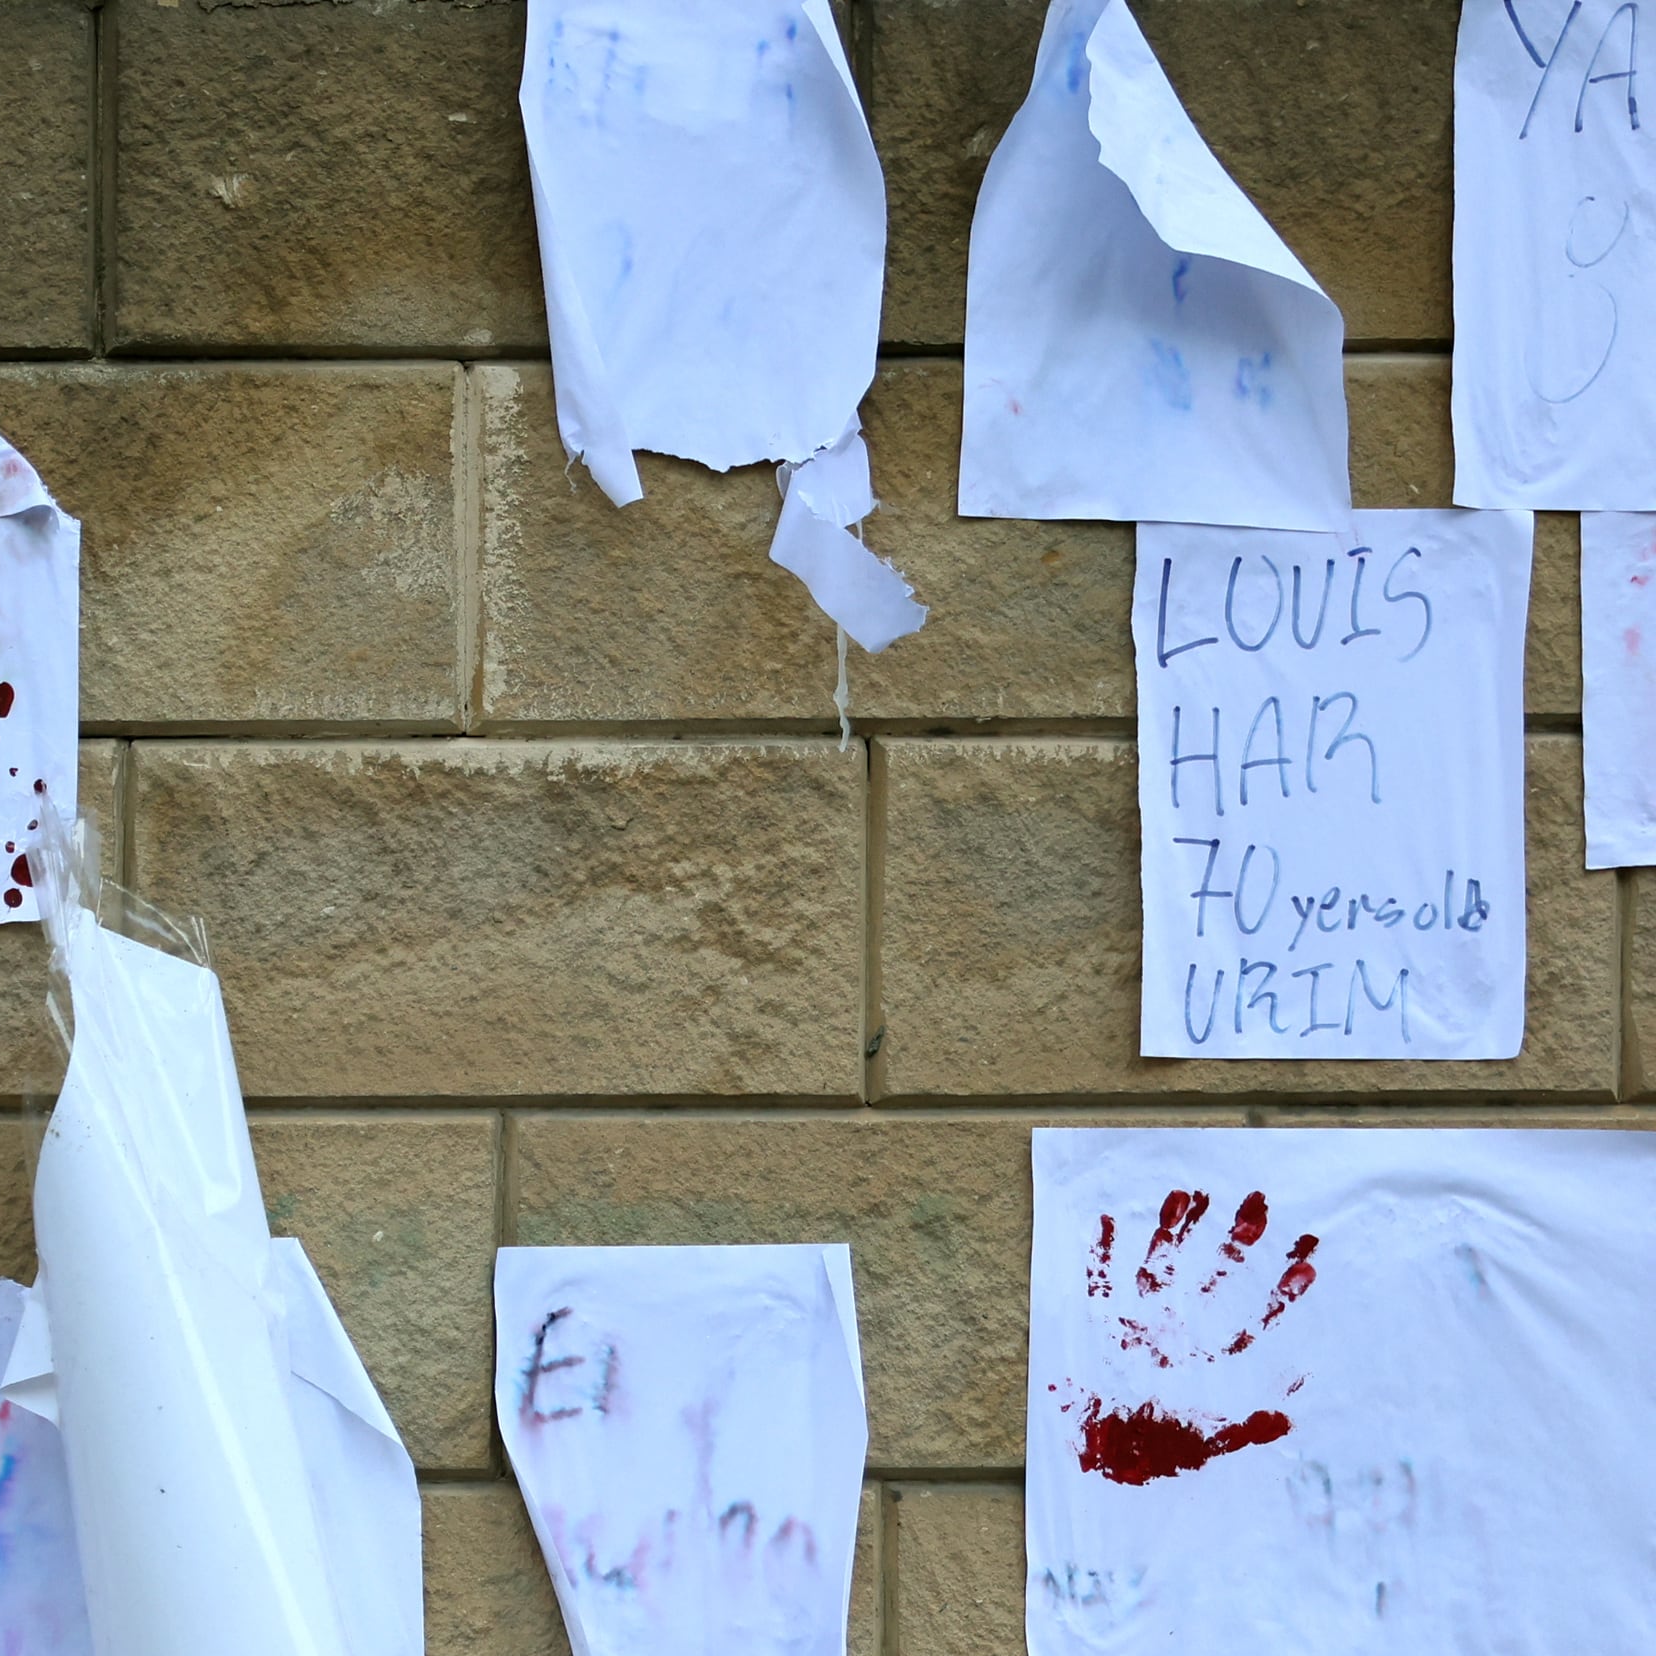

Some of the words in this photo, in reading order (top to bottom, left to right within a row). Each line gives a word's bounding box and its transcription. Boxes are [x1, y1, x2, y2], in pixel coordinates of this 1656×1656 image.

[1158, 545, 1433, 668] LOUIS
[1172, 690, 1383, 815] HAR
[1172, 837, 1280, 937] 70
[1181, 958, 1417, 1045] URIM
